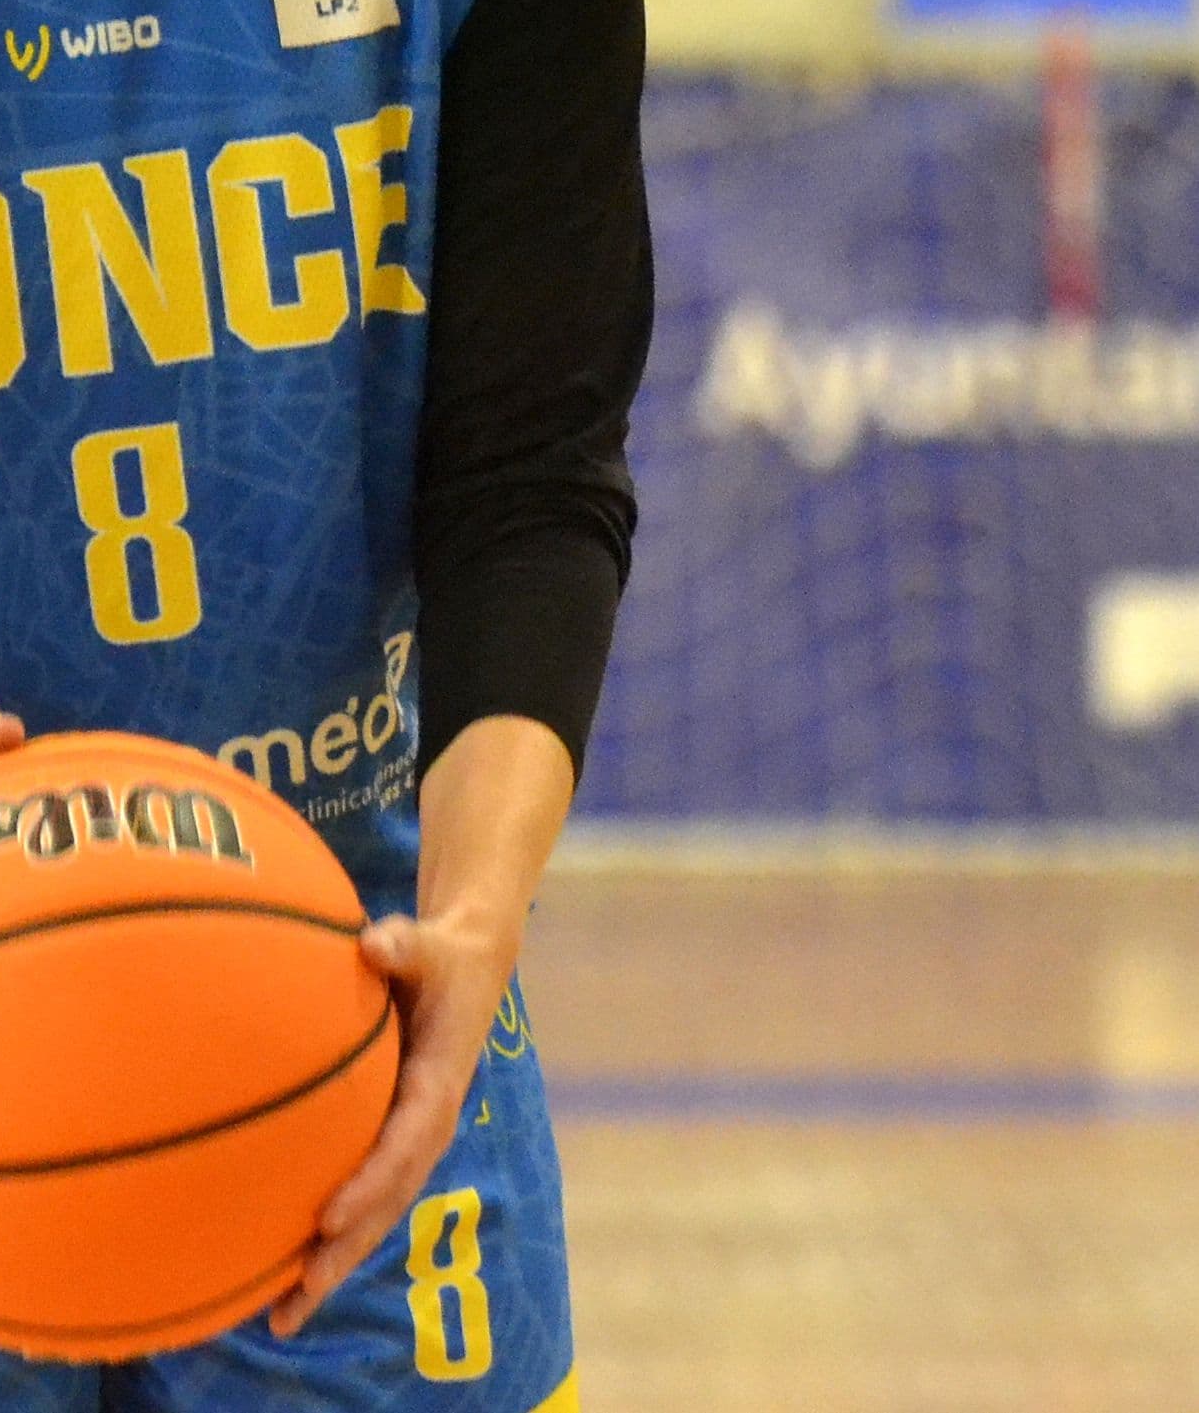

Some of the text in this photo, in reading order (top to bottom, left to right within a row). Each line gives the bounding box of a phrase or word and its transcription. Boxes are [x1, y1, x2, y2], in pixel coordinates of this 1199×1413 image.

[60, 15, 162, 59] WIBO
[71, 422, 203, 645] 8
[405, 1186, 494, 1383] 8
